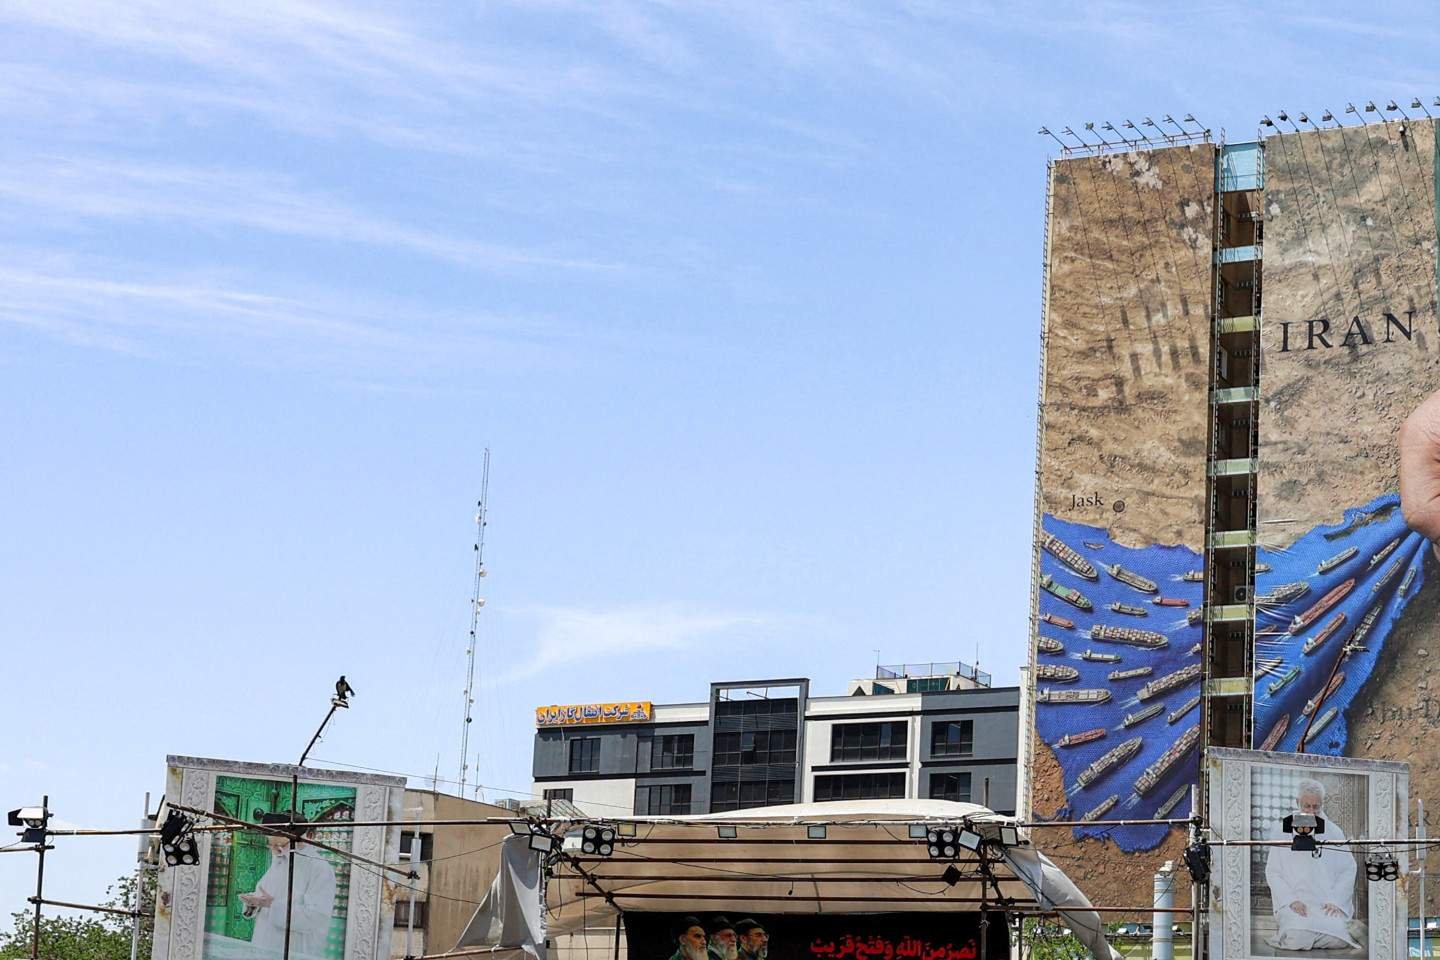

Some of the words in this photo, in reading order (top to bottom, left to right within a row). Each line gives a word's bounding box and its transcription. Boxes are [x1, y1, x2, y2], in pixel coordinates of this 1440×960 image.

[1276, 310, 1416, 352] IRAN
[1068, 491, 1104, 511] Jask
[537, 708, 561, 725] ایران
[575, 704, 603, 722] انتقال
[604, 704, 630, 720] شرکت
